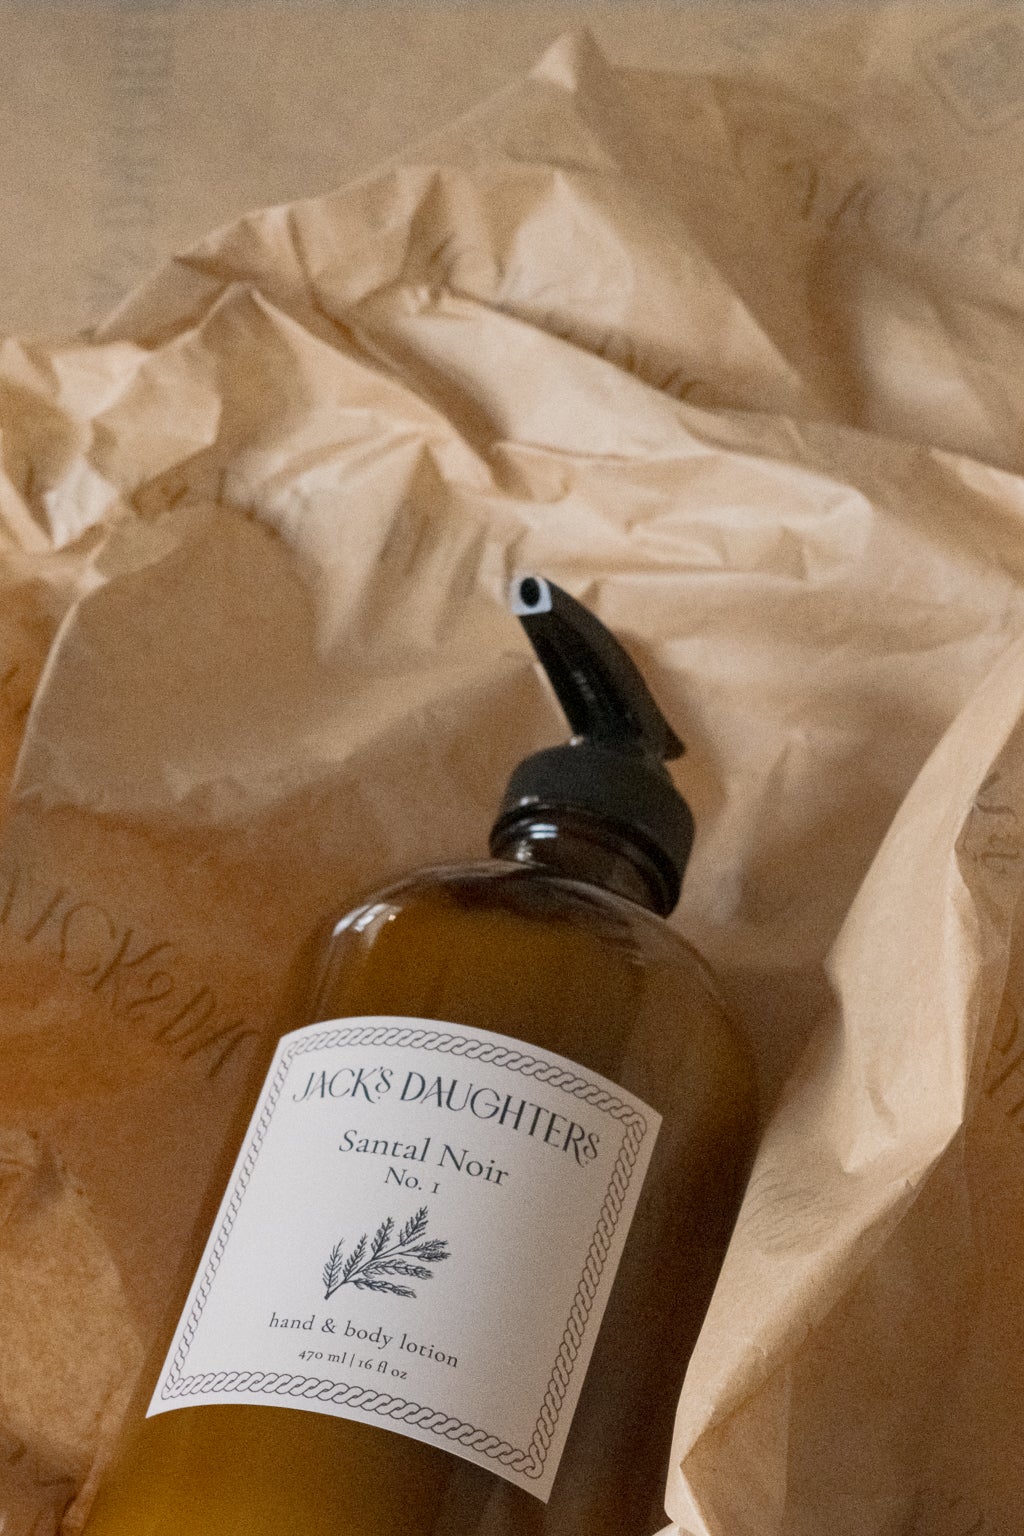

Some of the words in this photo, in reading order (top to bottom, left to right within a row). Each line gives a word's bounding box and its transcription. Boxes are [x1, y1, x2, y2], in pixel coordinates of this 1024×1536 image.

[293, 1066, 394, 1104] JACK'S
[400, 1071, 601, 1168] DAUGHTERS
[338, 1129, 432, 1162] Santal
[437, 1143, 510, 1187] Noir
[384, 1166, 423, 1191] No.
[268, 1312, 316, 1331] hand
[321, 1317, 336, 1334] &
[344, 1320, 394, 1350] body
[399, 1333, 460, 1368] lotion
[298, 1350, 324, 1362] 470
[328, 1351, 347, 1364] ml
[358, 1358, 373, 1370] 16
[376, 1360, 388, 1374] fl
[391, 1368, 409, 1380] oz
